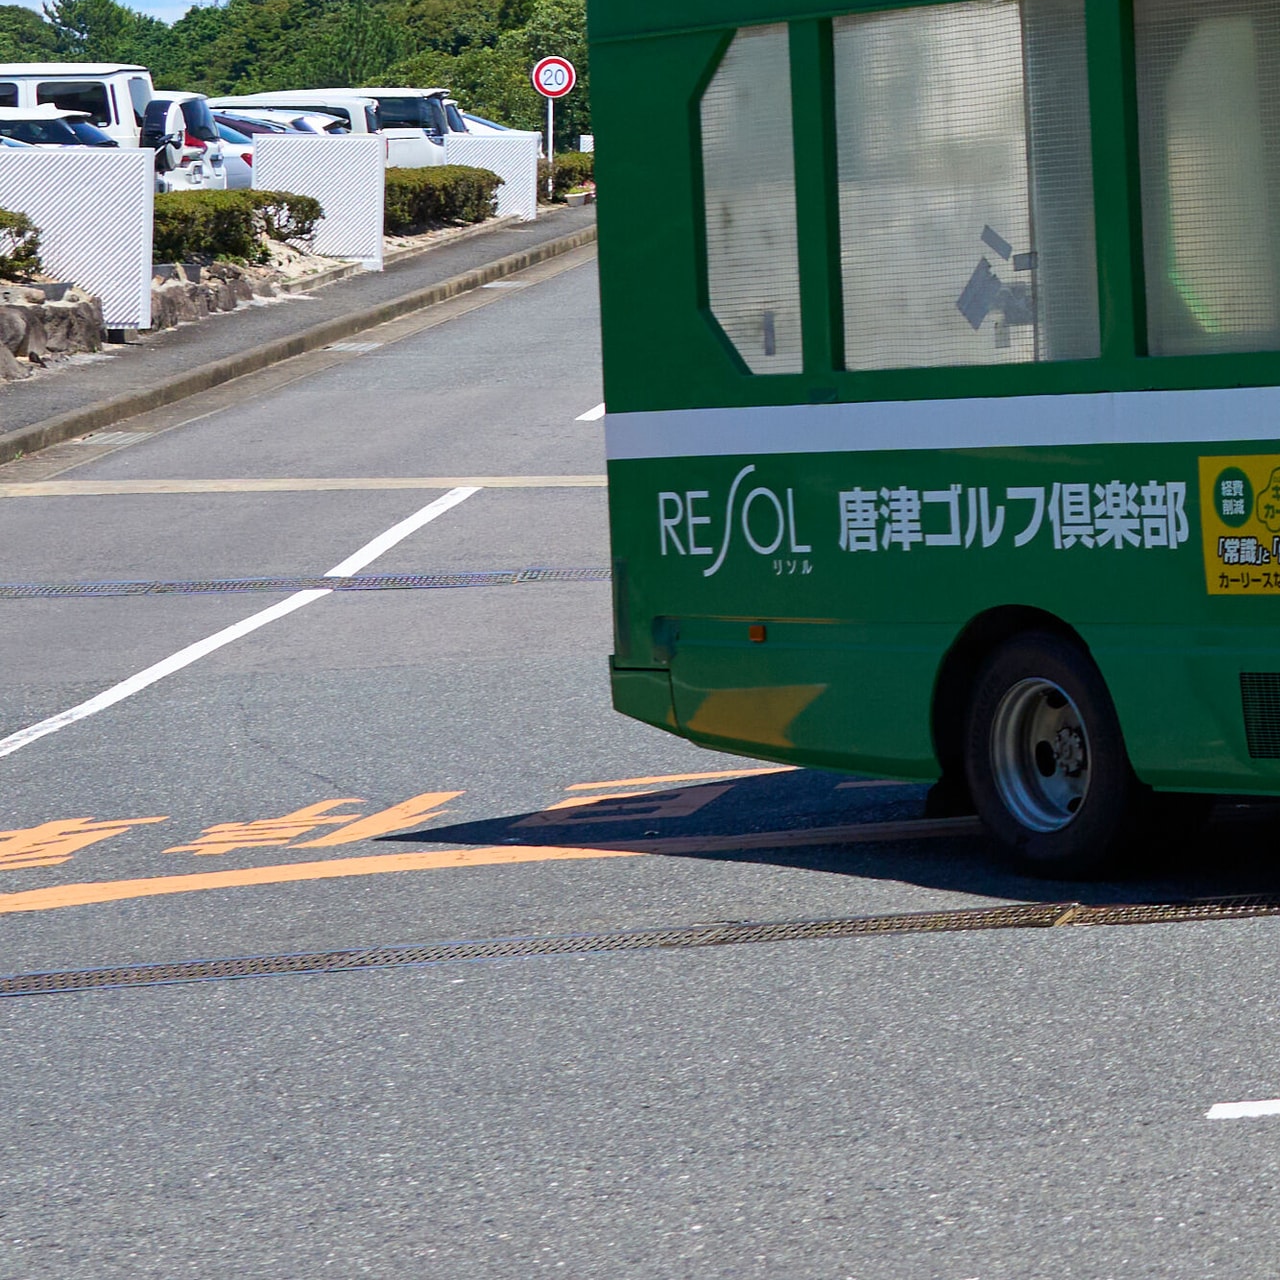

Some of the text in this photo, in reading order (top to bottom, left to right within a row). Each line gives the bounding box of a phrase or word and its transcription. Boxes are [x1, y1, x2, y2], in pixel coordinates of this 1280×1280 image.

[543, 69, 565, 86] 20
[1221, 480, 1244, 496] 経費
[838, 479, 1190, 552] 唐津ゴルフ倶楽部
[1222, 499, 1245, 515] 削減
[657, 464, 812, 578] RESOL
[772, 559, 814, 576] リソル
